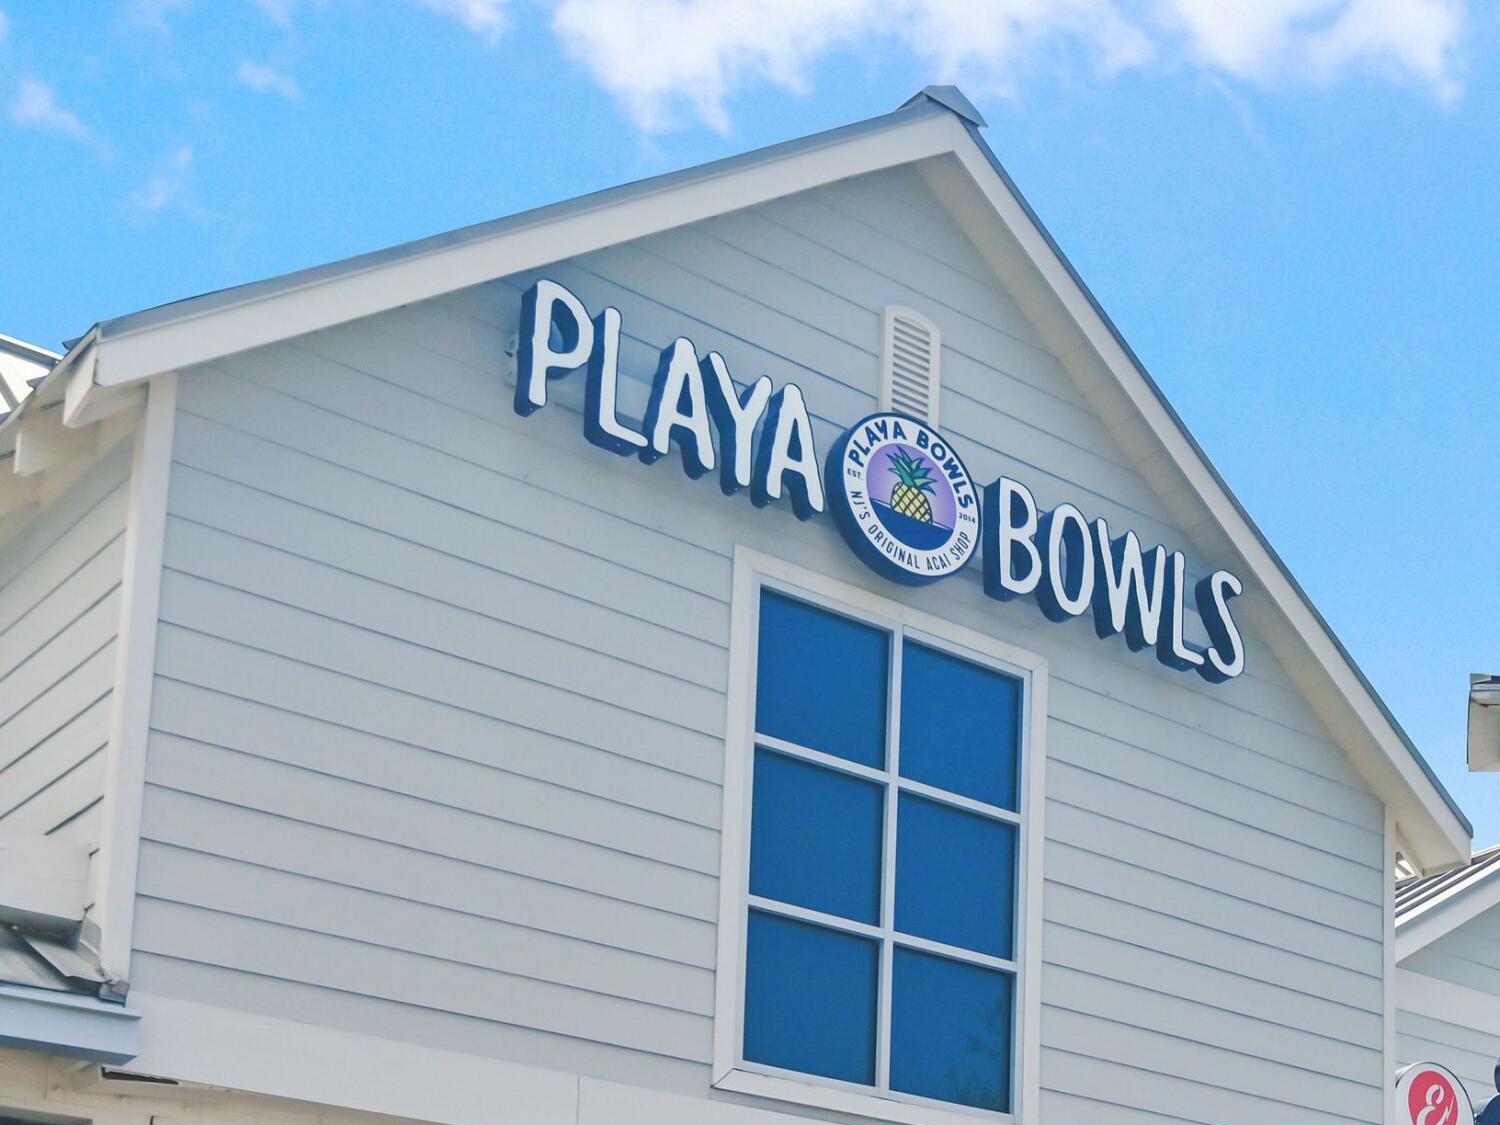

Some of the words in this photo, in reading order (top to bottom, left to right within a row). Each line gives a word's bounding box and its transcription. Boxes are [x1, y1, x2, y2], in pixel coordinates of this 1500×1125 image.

[513, 279, 824, 521] PLAYA
[984, 476, 1244, 684] BOWLS
[847, 468, 863, 480] EST.
[848, 419, 907, 468] PLAYA
[916, 429, 973, 509] BOWLS
[850, 490, 871, 520] NJ'S
[868, 524, 920, 569] ORIGINAL
[926, 553, 952, 572] ACAI
[950, 531, 971, 560] SHOP
[958, 512, 976, 524] 2014
